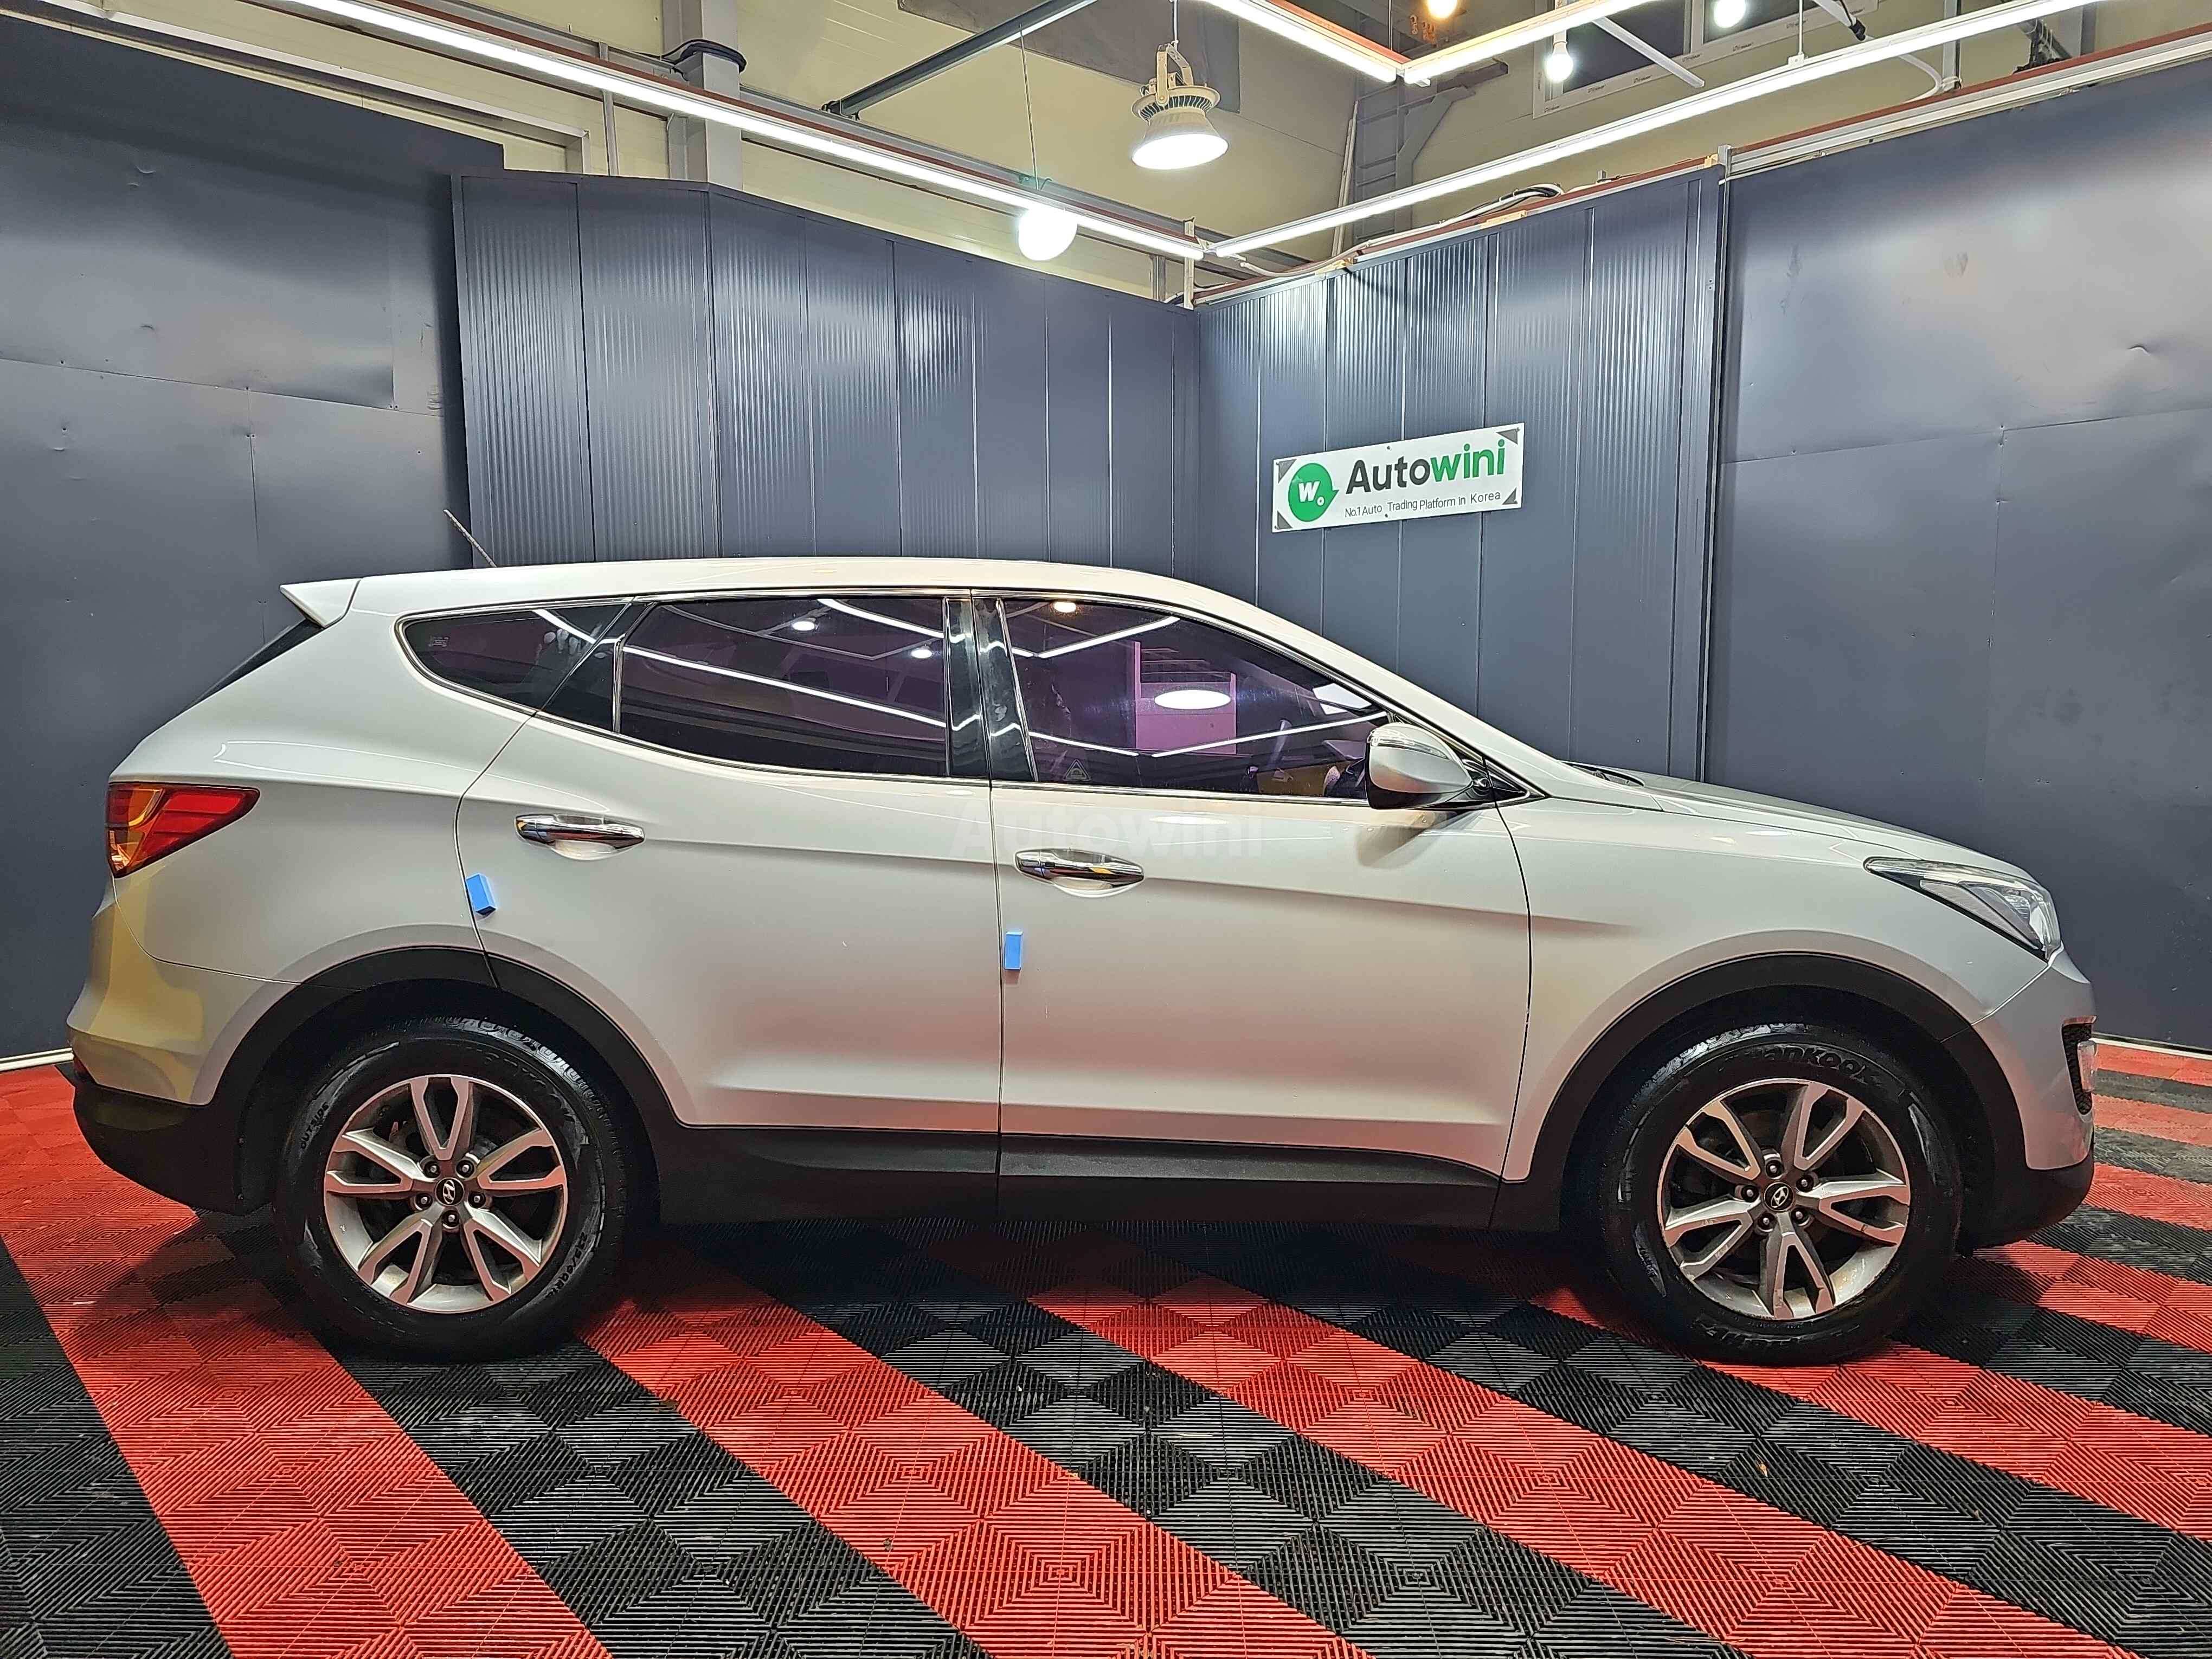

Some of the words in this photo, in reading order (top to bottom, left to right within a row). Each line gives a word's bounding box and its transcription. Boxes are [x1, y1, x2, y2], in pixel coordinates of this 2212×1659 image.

[1346, 439, 1505, 494] Autowini
[1345, 506, 1360, 518] No.1
[1362, 505, 1382, 516] Auto
[1387, 499, 1418, 511] Trading
[1419, 497, 1456, 510] Platform
[1458, 496, 1466, 505] in
[1470, 492, 1501, 504] Korea
